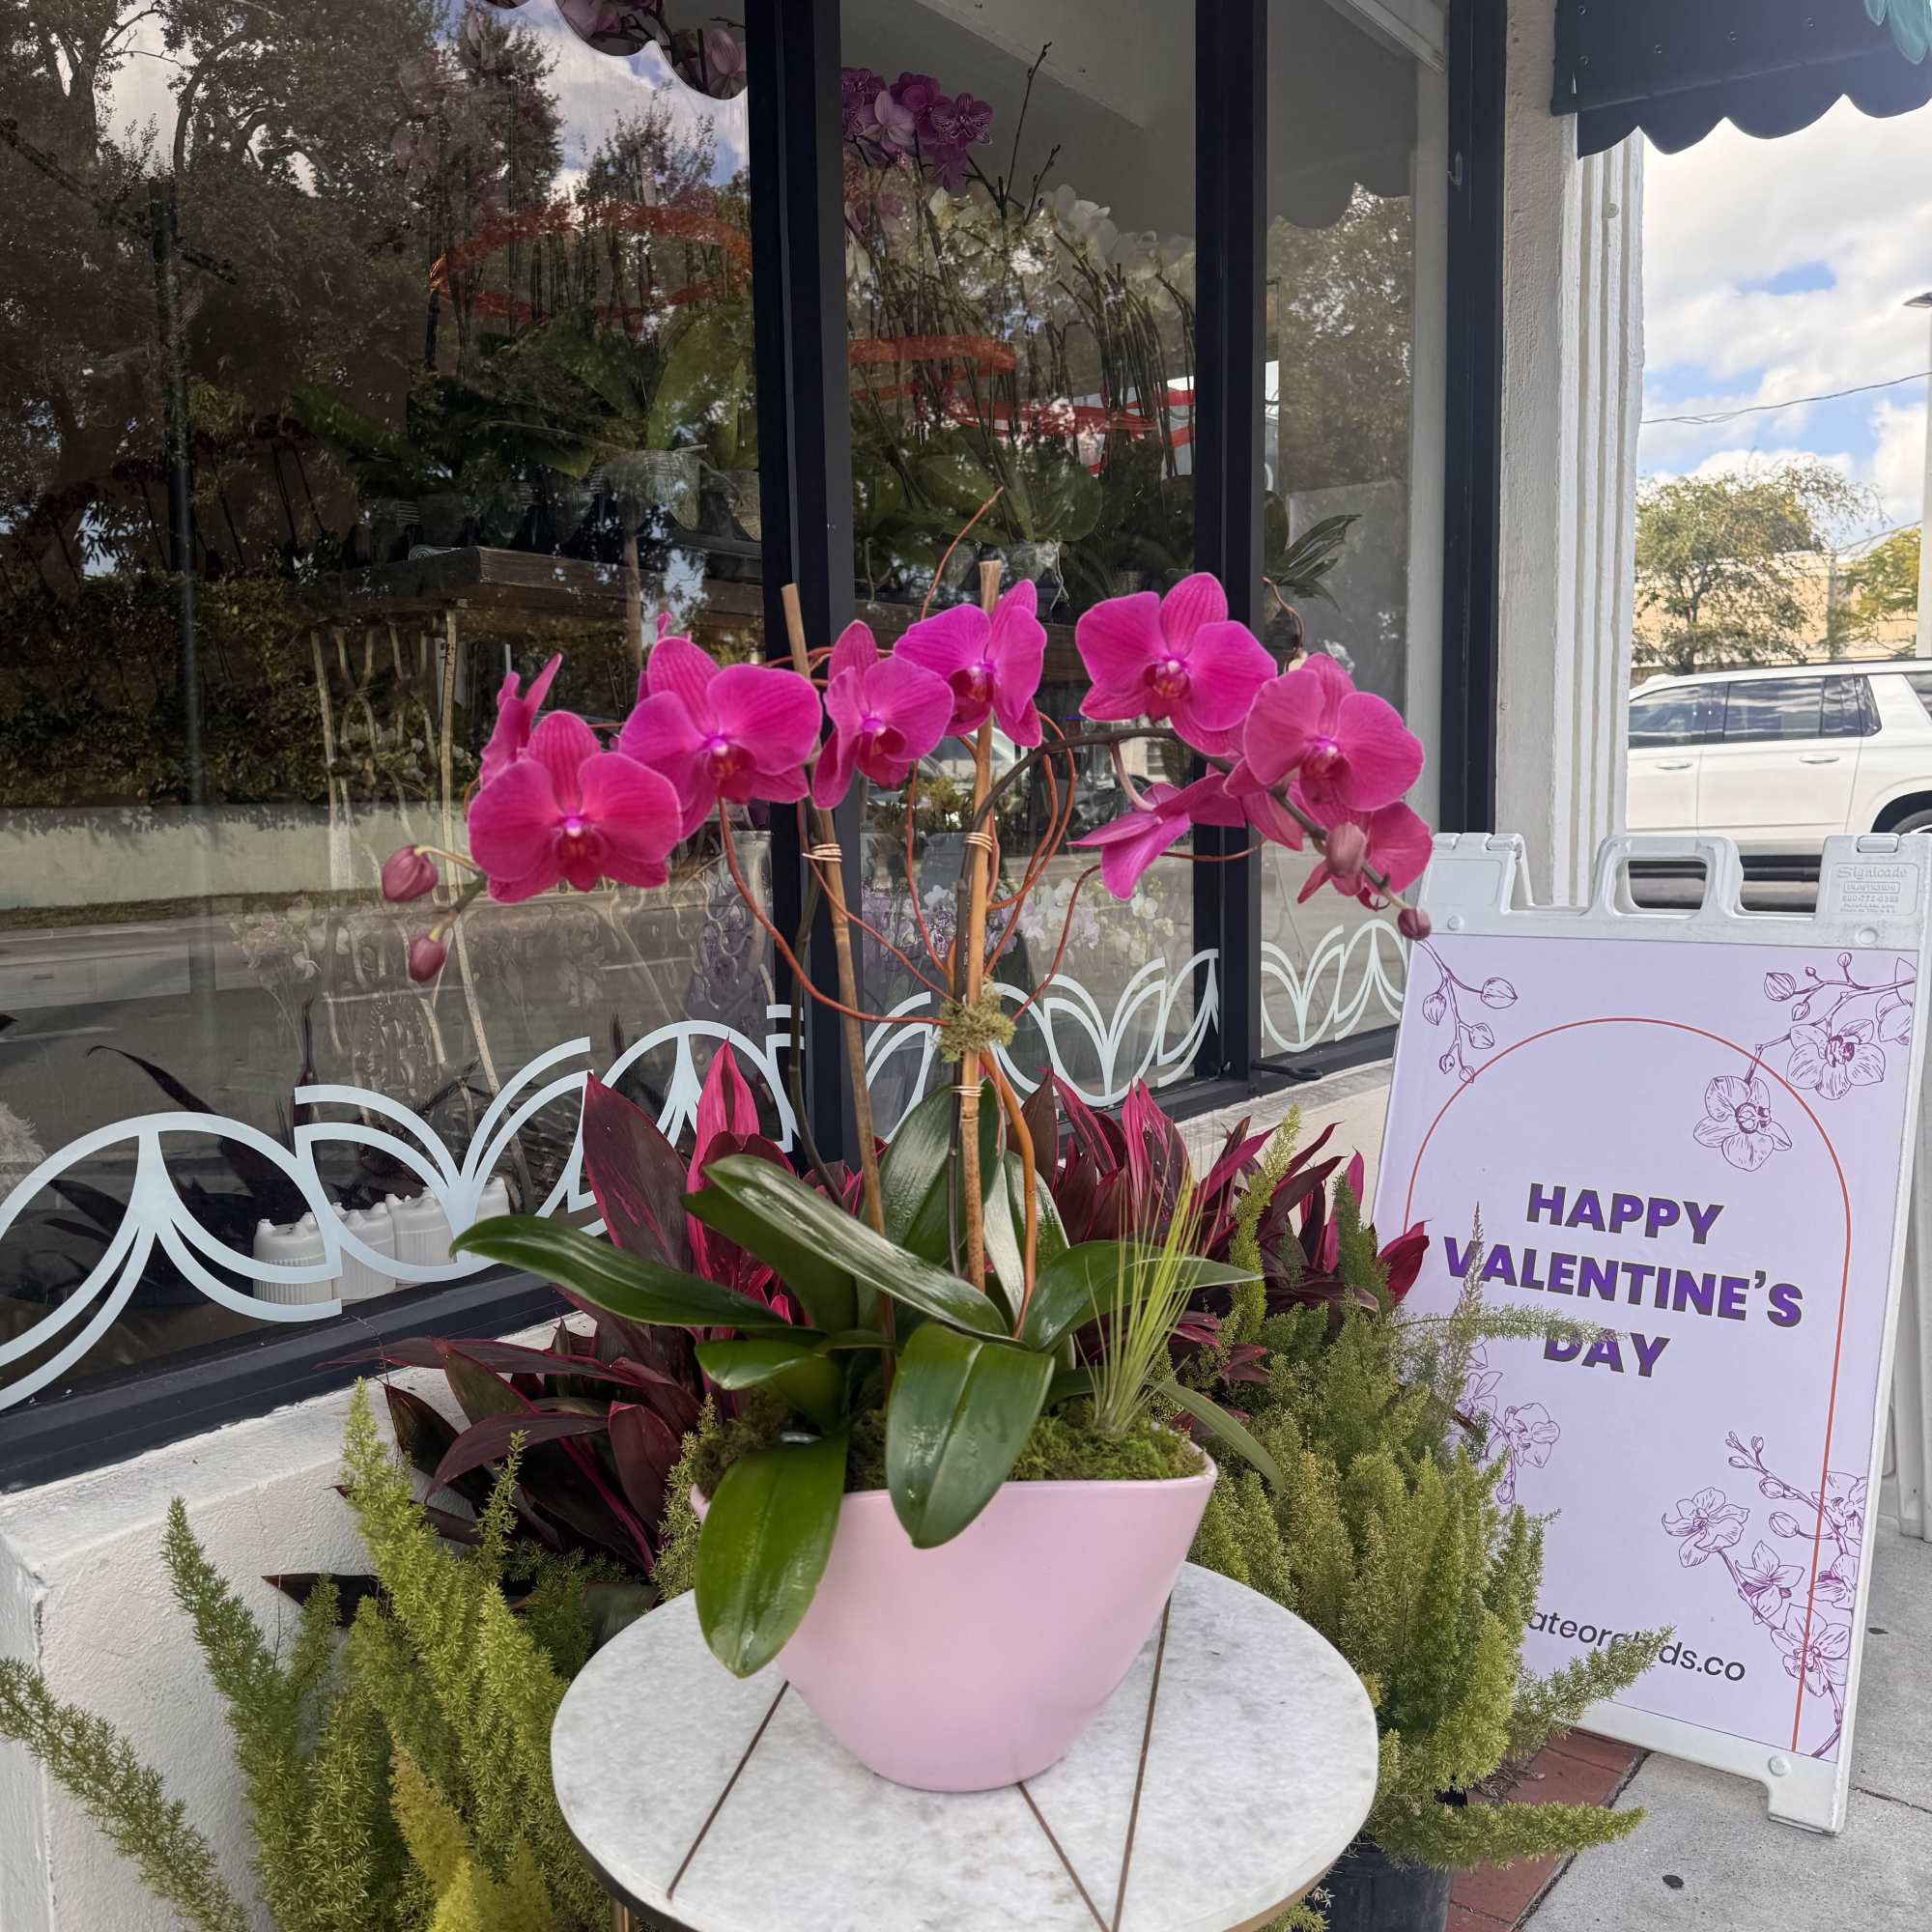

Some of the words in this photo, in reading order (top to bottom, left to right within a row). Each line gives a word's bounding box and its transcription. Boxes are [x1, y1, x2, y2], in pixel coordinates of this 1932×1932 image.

[1526, 1182, 1724, 1244] HAPPY
[1444, 1236, 1804, 1327] VALENTINE’S
[1543, 1325, 1671, 1378] DAY
[1527, 1611, 1747, 1682] ateords.co
